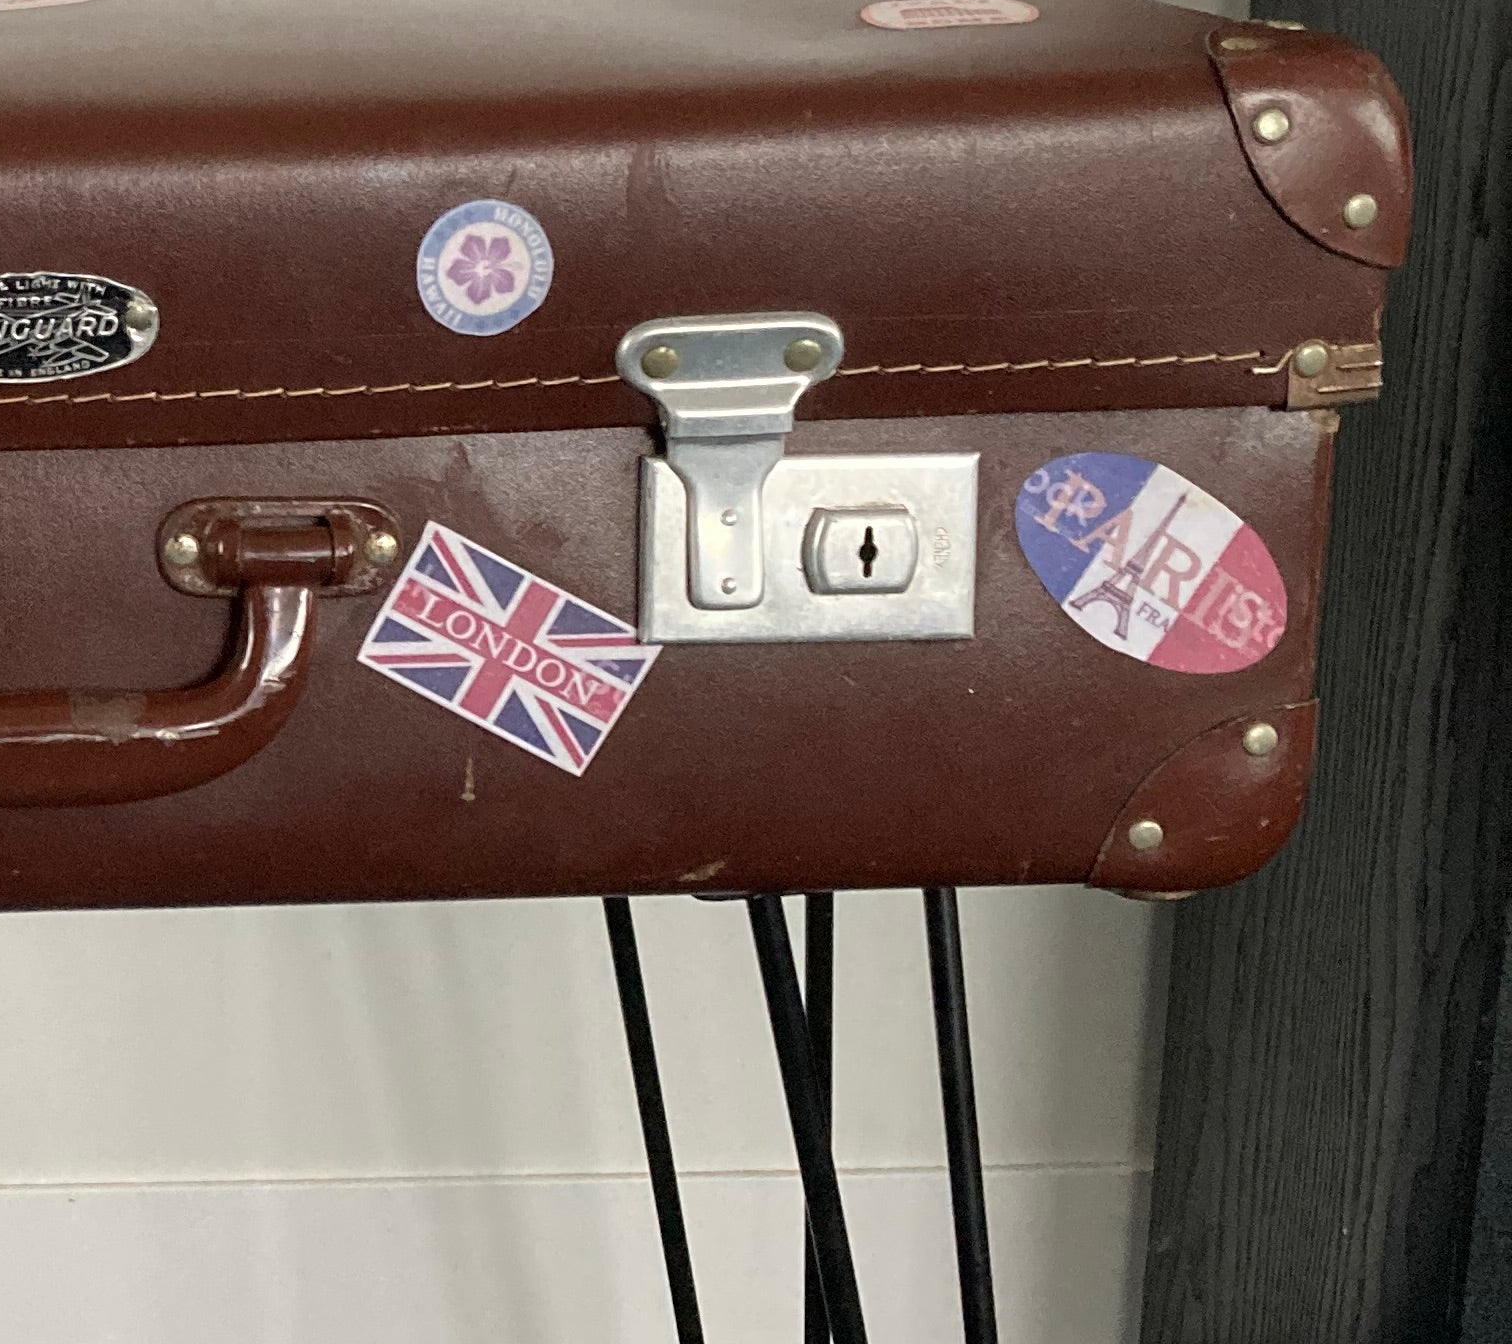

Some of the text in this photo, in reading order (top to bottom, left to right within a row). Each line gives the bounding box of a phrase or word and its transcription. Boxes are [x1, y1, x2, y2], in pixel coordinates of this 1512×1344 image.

[15, 275, 61, 291] LIGHT
[66, 279, 107, 296] WITH
[421, 256, 464, 328] HAWAII
[492, 206, 550, 300] HONOLULU
[7, 368, 23, 377] IN
[30, 359, 91, 377] ENGLAND
[1034, 468, 1264, 649] PARIS
[416, 589, 602, 706] LONDON
